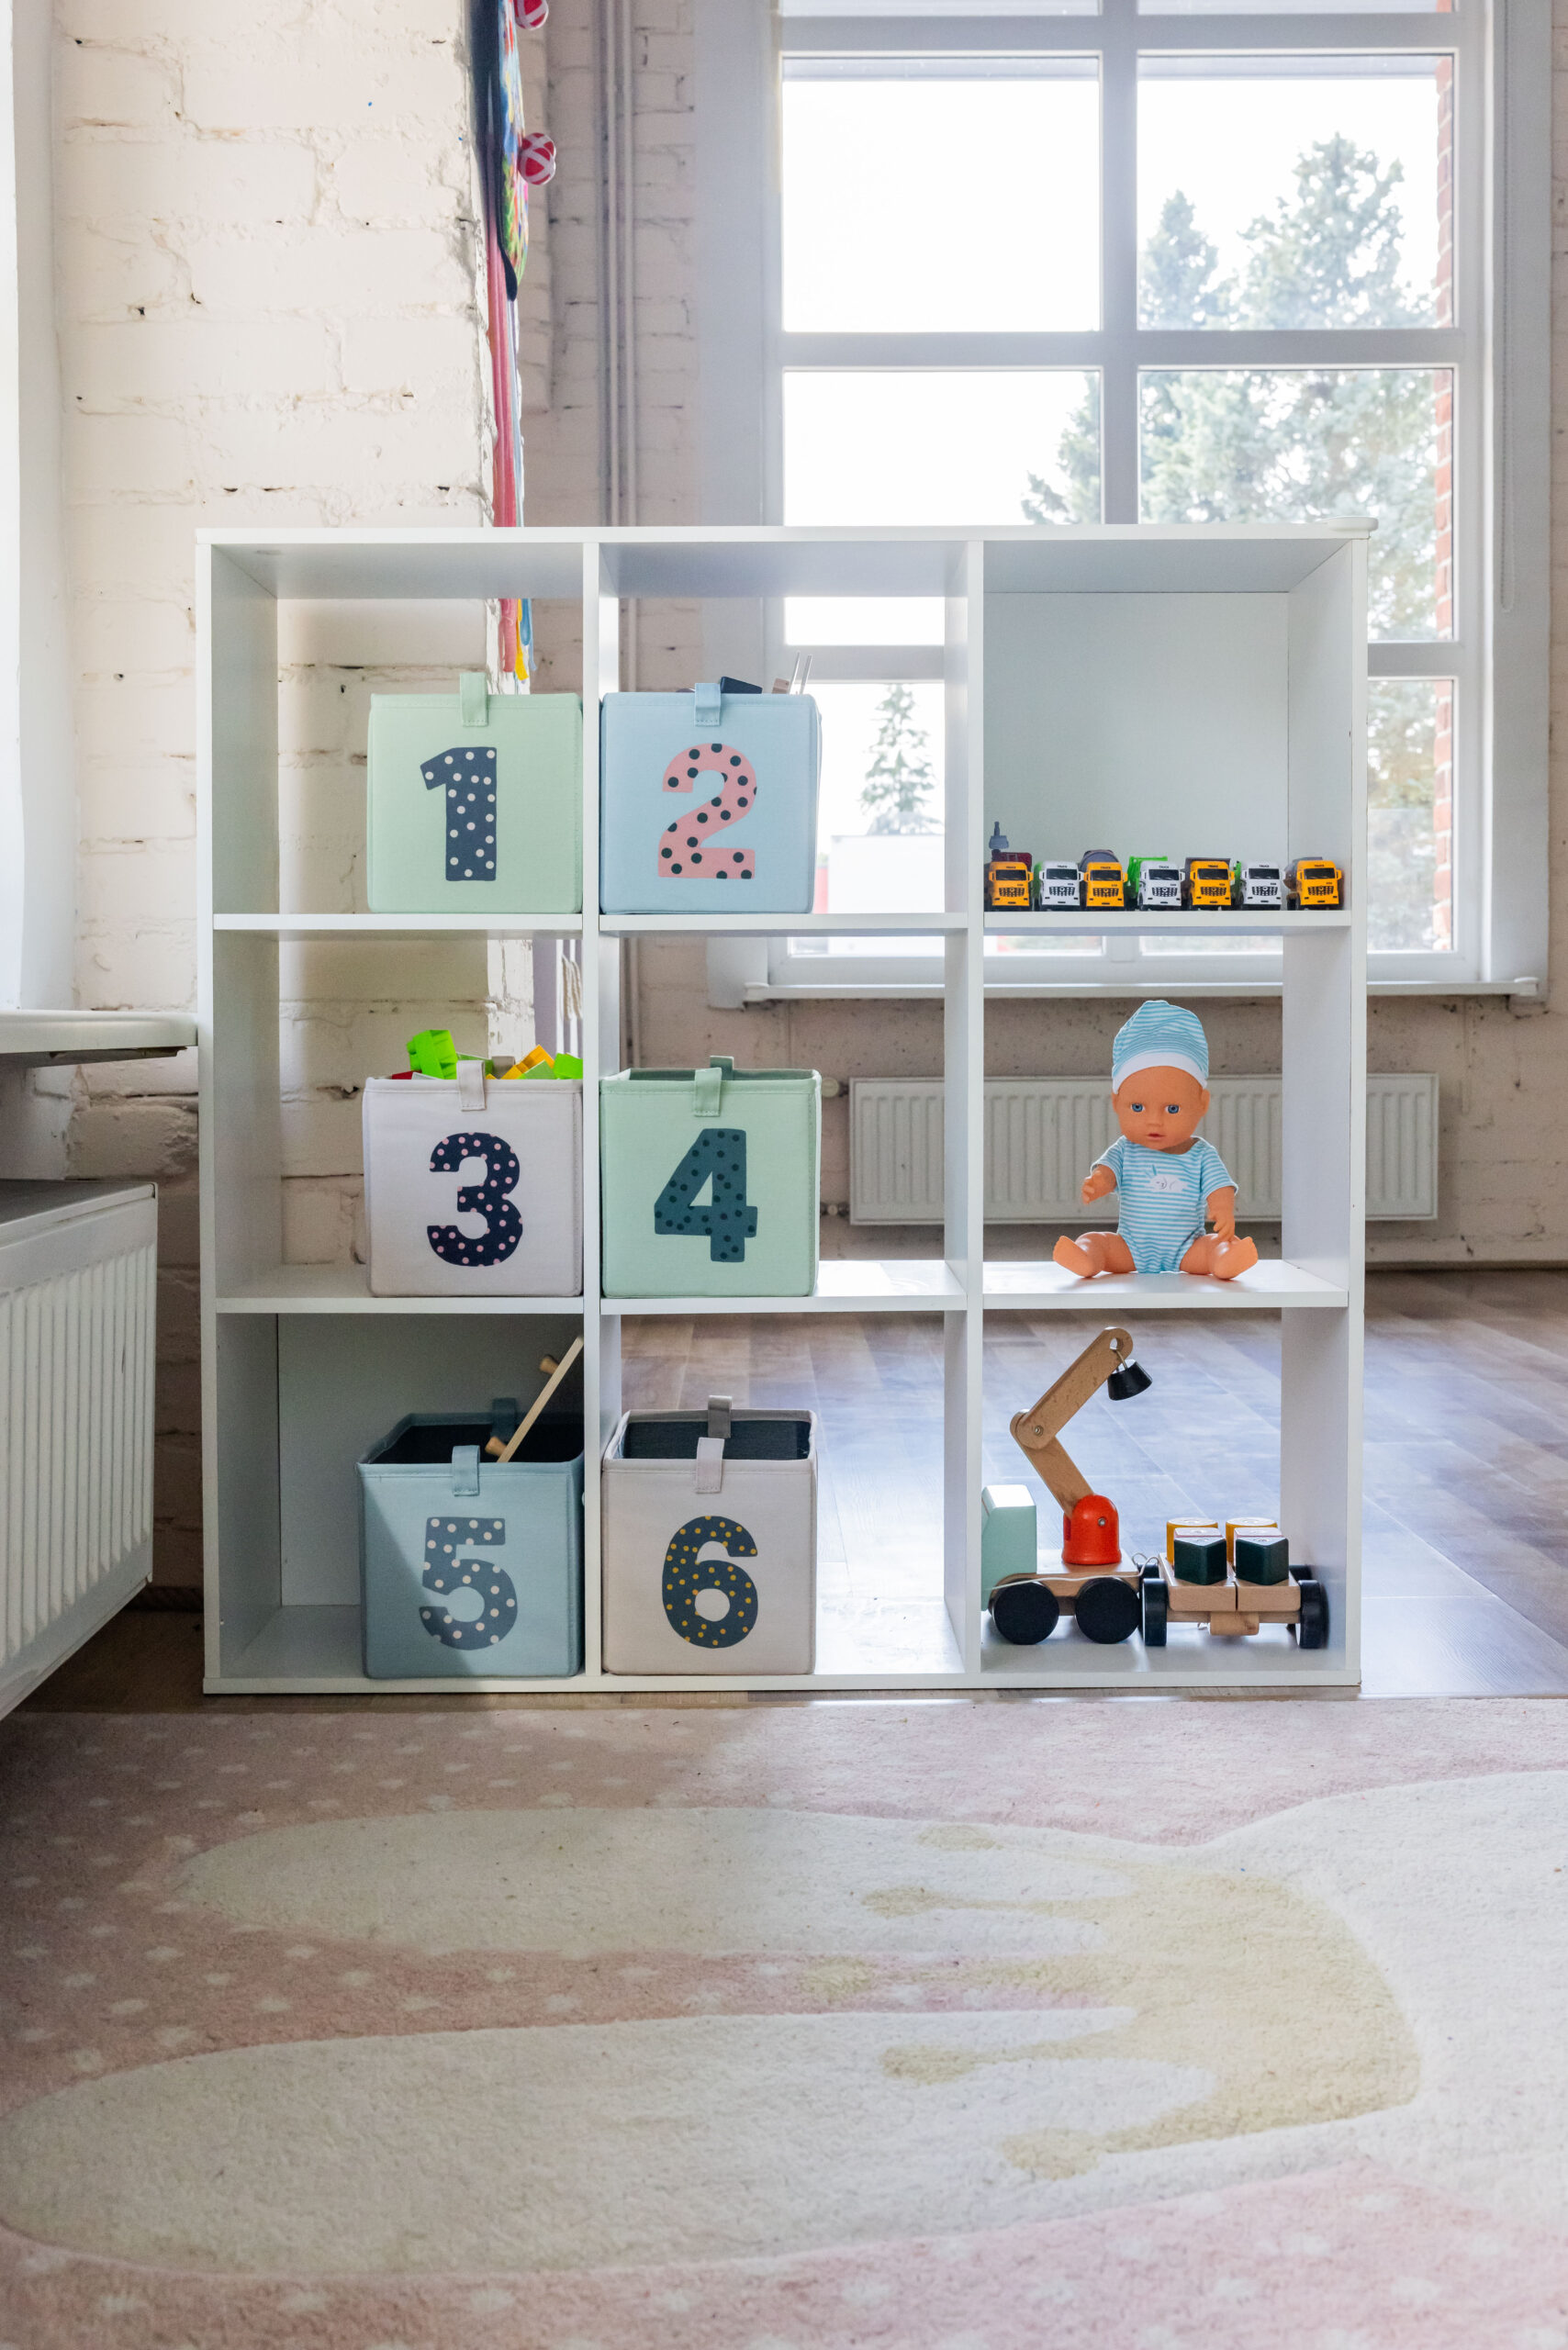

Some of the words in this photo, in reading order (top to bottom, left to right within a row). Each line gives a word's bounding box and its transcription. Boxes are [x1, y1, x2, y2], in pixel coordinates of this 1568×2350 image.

[420, 746, 498, 881] 1
[658, 743, 757, 879] 2
[427, 1132, 523, 1267] 3
[654, 1128, 758, 1263] 4
[419, 1516, 518, 1651] 5
[661, 1516, 758, 1649] 6
